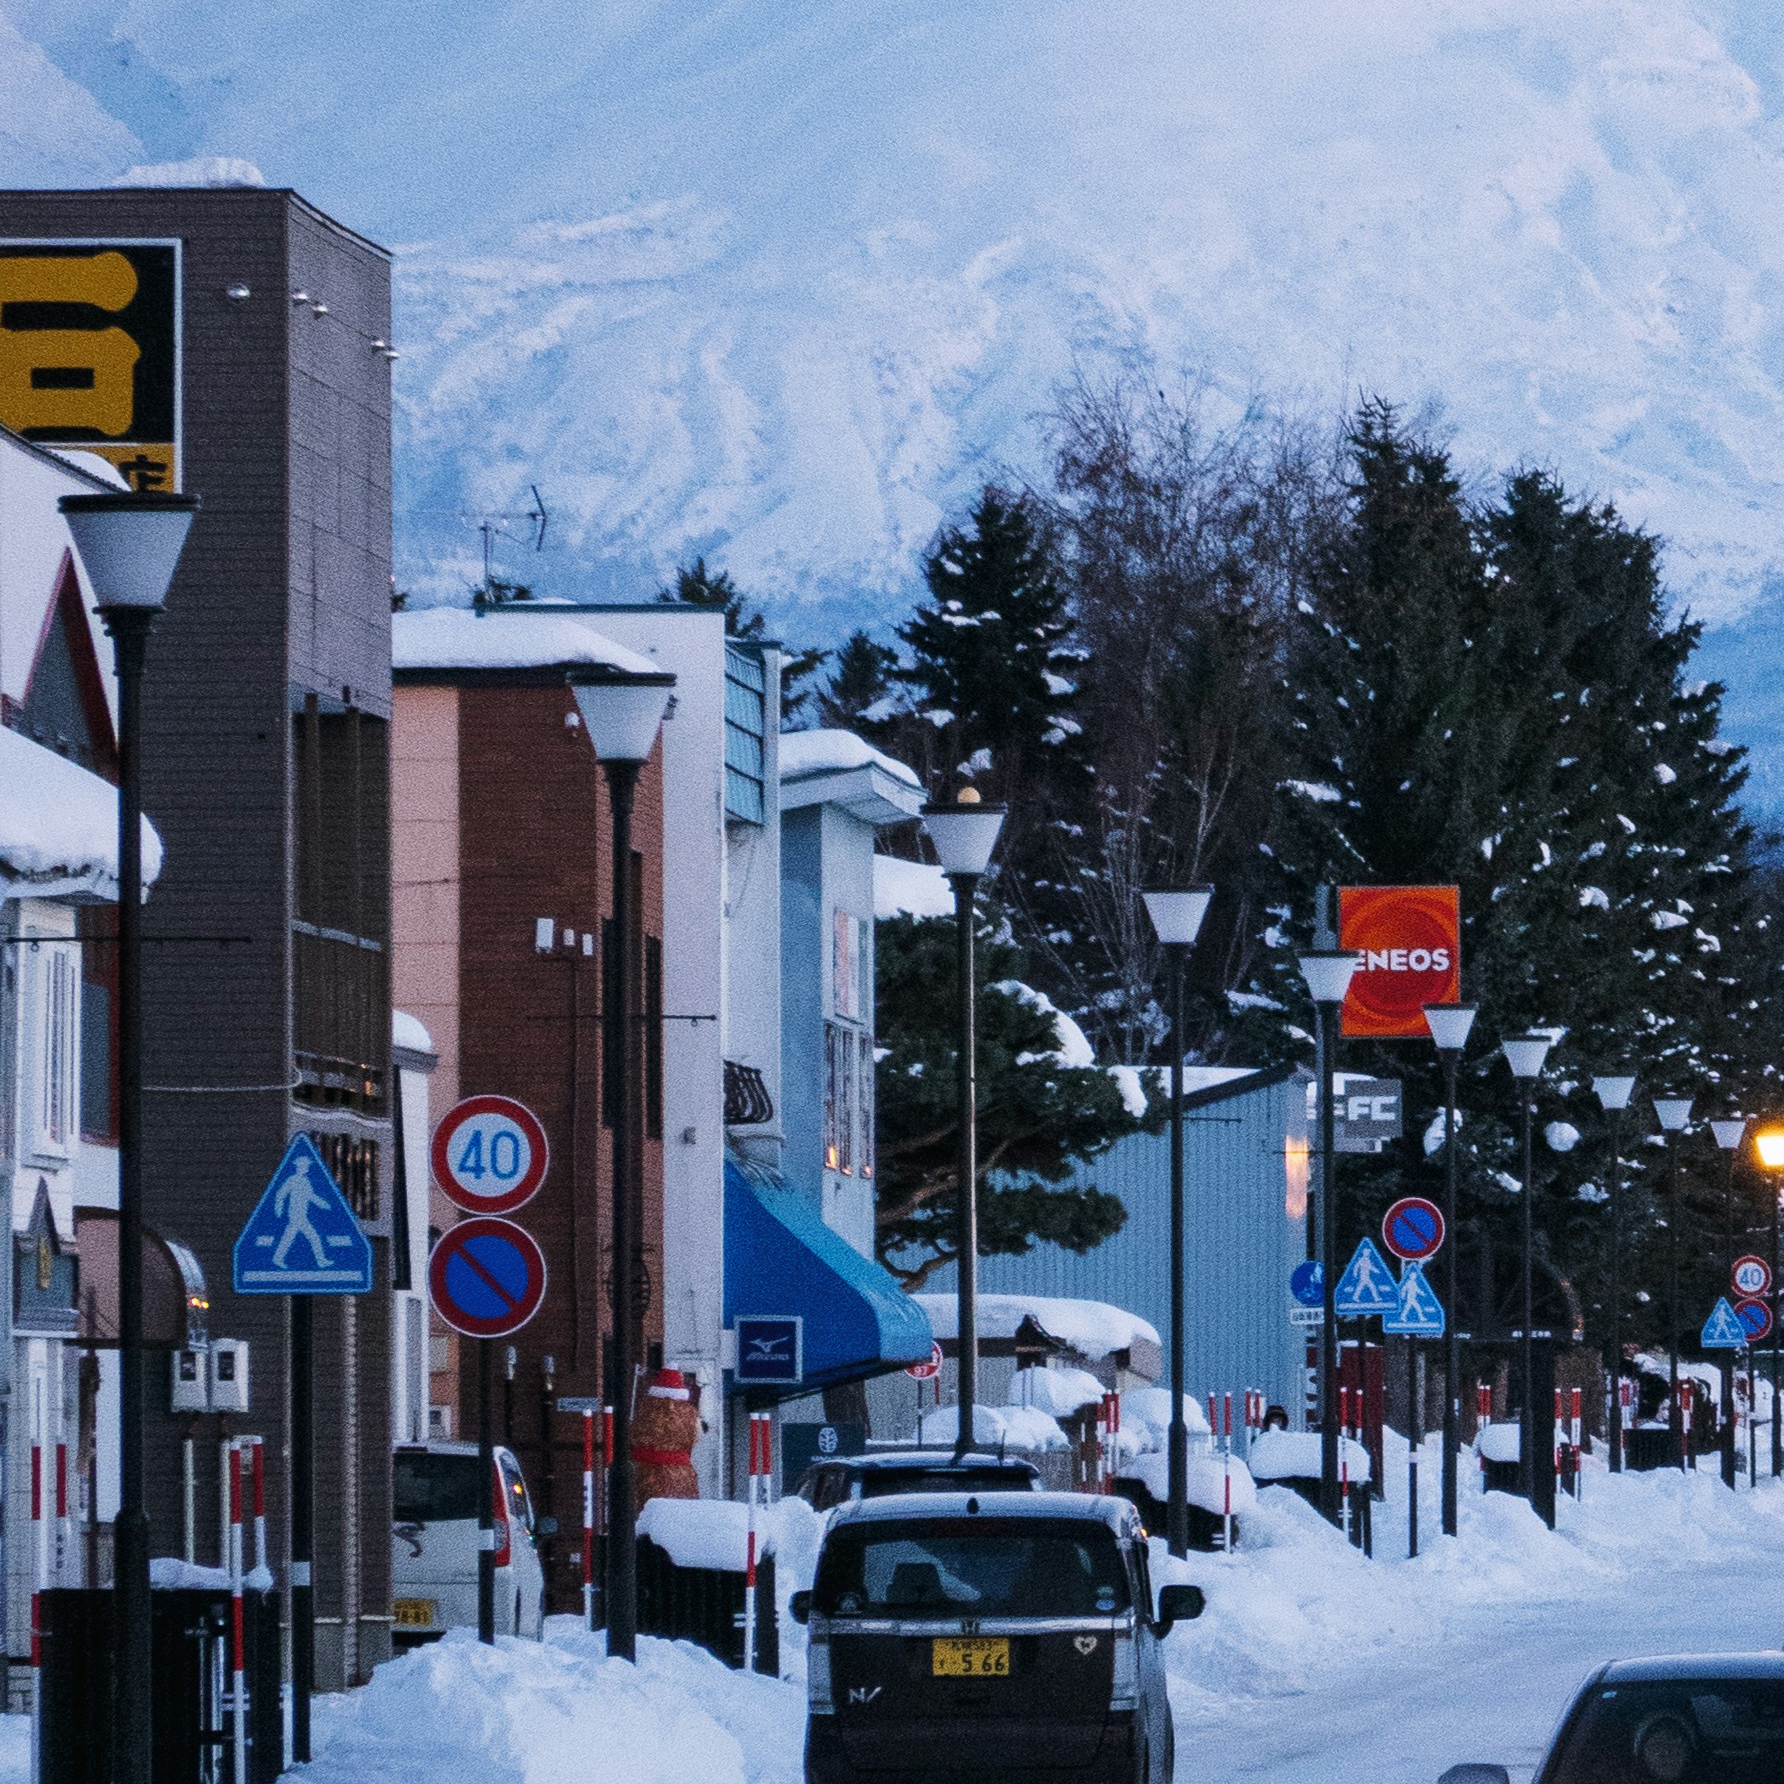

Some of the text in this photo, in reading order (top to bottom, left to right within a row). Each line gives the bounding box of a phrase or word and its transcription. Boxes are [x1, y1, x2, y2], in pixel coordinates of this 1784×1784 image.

[1356, 948, 1451, 972] ENEOS
[458, 1130, 520, 1181] 40
[1738, 1268, 1762, 1287] 40
